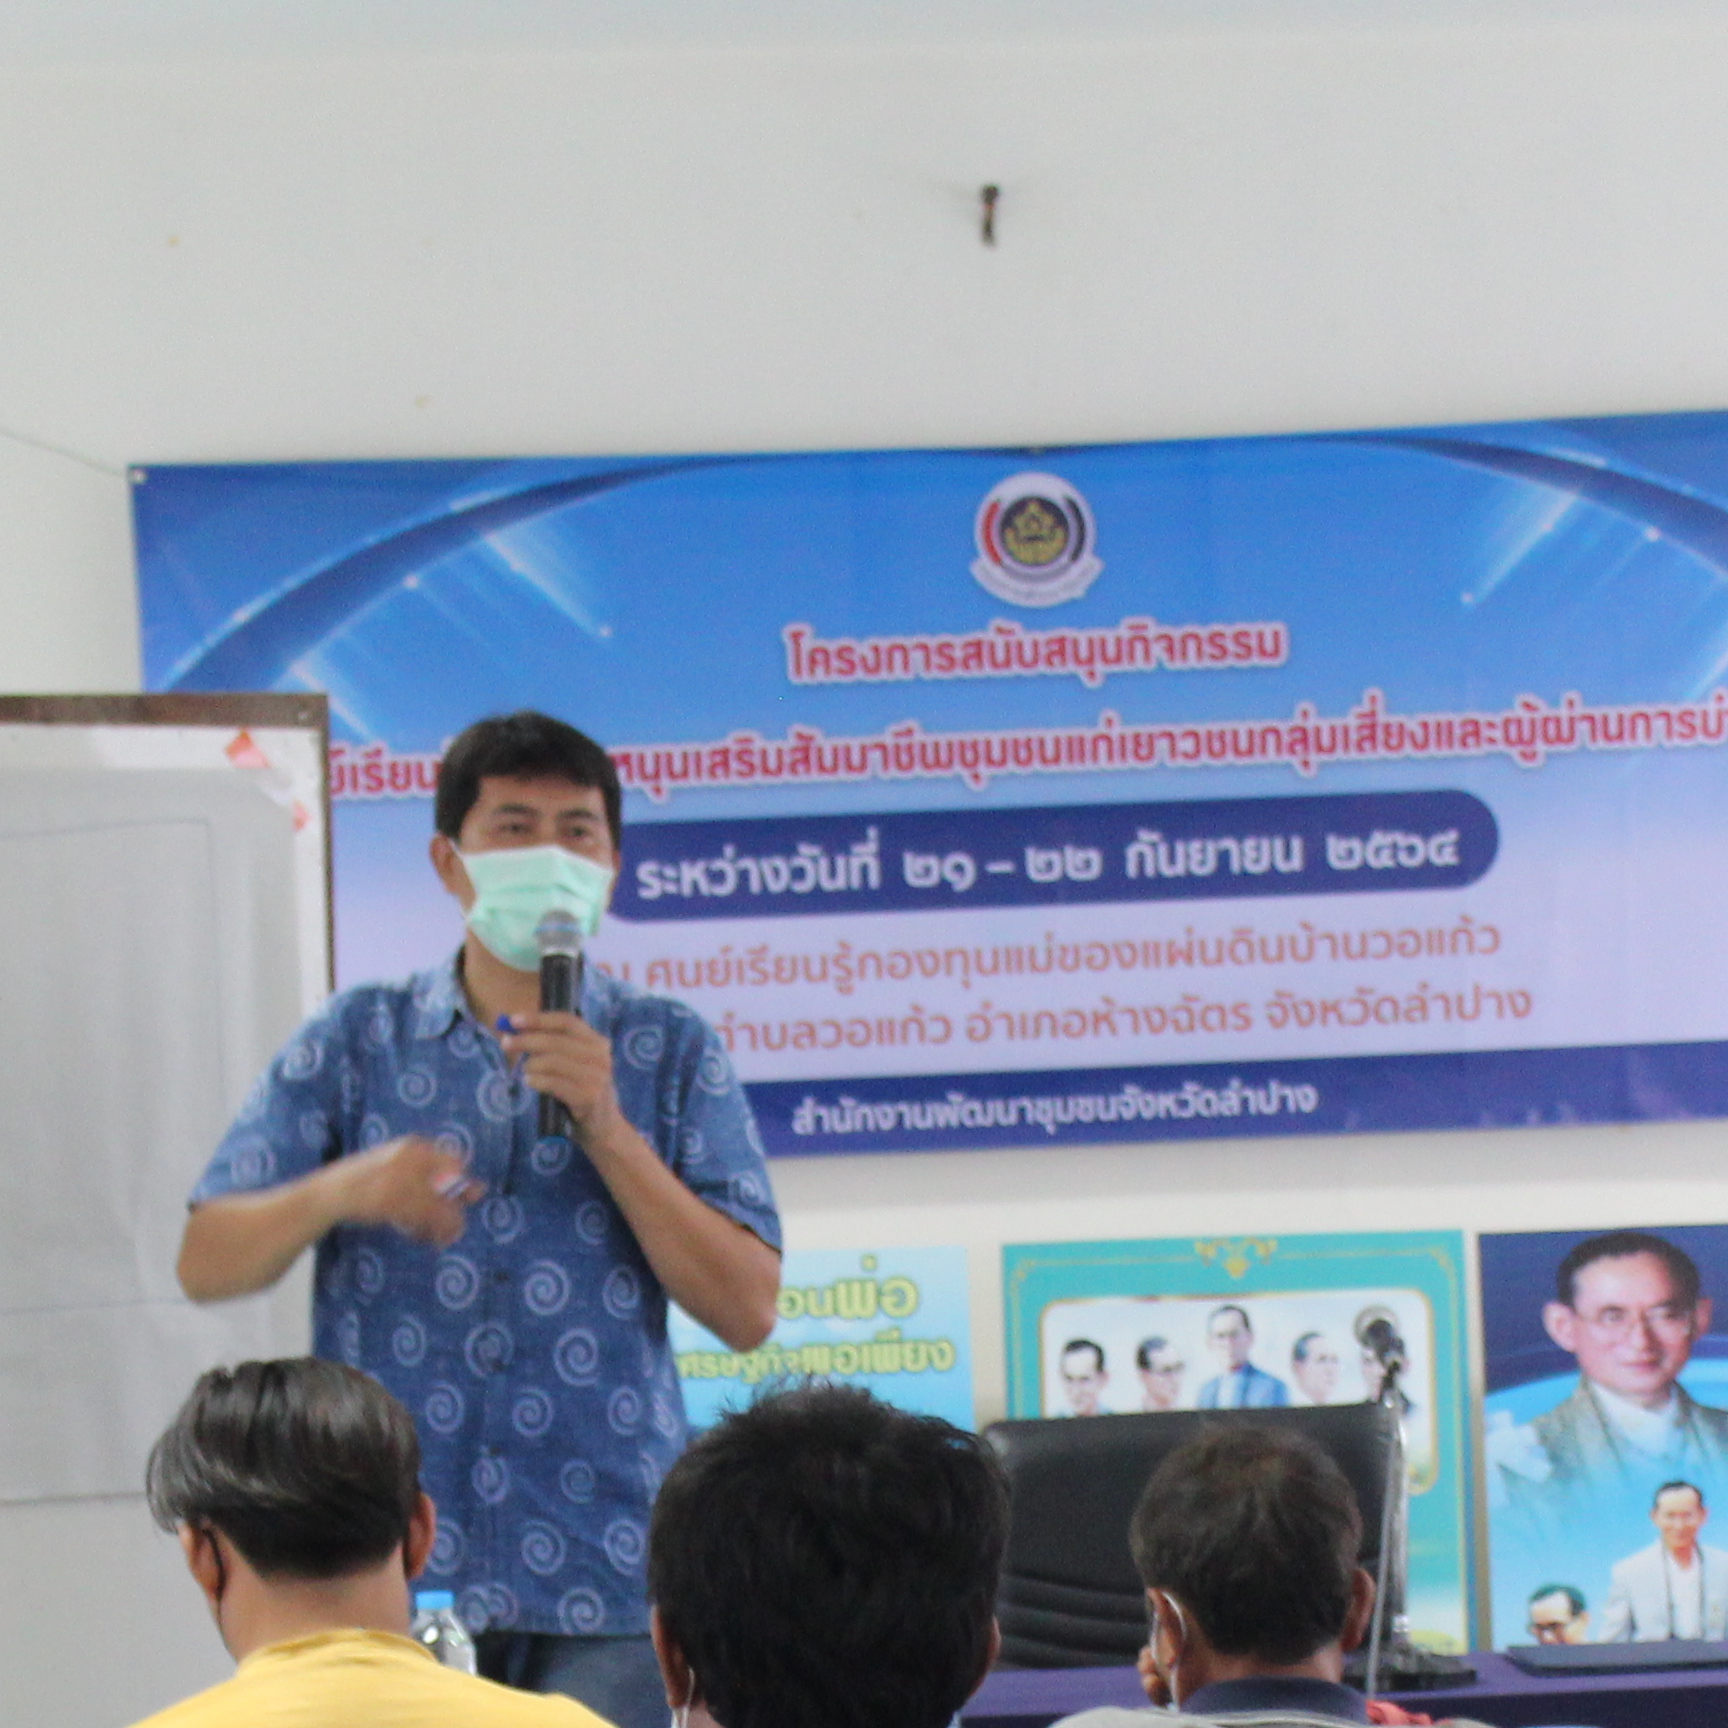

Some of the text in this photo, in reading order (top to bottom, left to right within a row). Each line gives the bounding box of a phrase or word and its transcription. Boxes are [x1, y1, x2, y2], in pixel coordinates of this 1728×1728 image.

[786, 619, 1282, 684] โครงการสนับสนุนกิจกรรม
[637, 830, 878, 899] ระหว่างวันที่
[903, 849, 975, 890] ๒๑
[1025, 845, 1101, 882] ๒๒
[1125, 828, 1304, 878] กันยายน
[646, 913, 1501, 995] ศนย์เรียนรู้กองทุนแม่ของแผ่นดินบ้านวอแก้ว
[966, 993, 1253, 1043] อำเภอห้างฉัตร
[1266, 981, 1532, 1030] จังหวัดลำปาง
[792, 1078, 1319, 1135] สำนักงานพัฒนาชุมชนจังหวัดลำปาง
